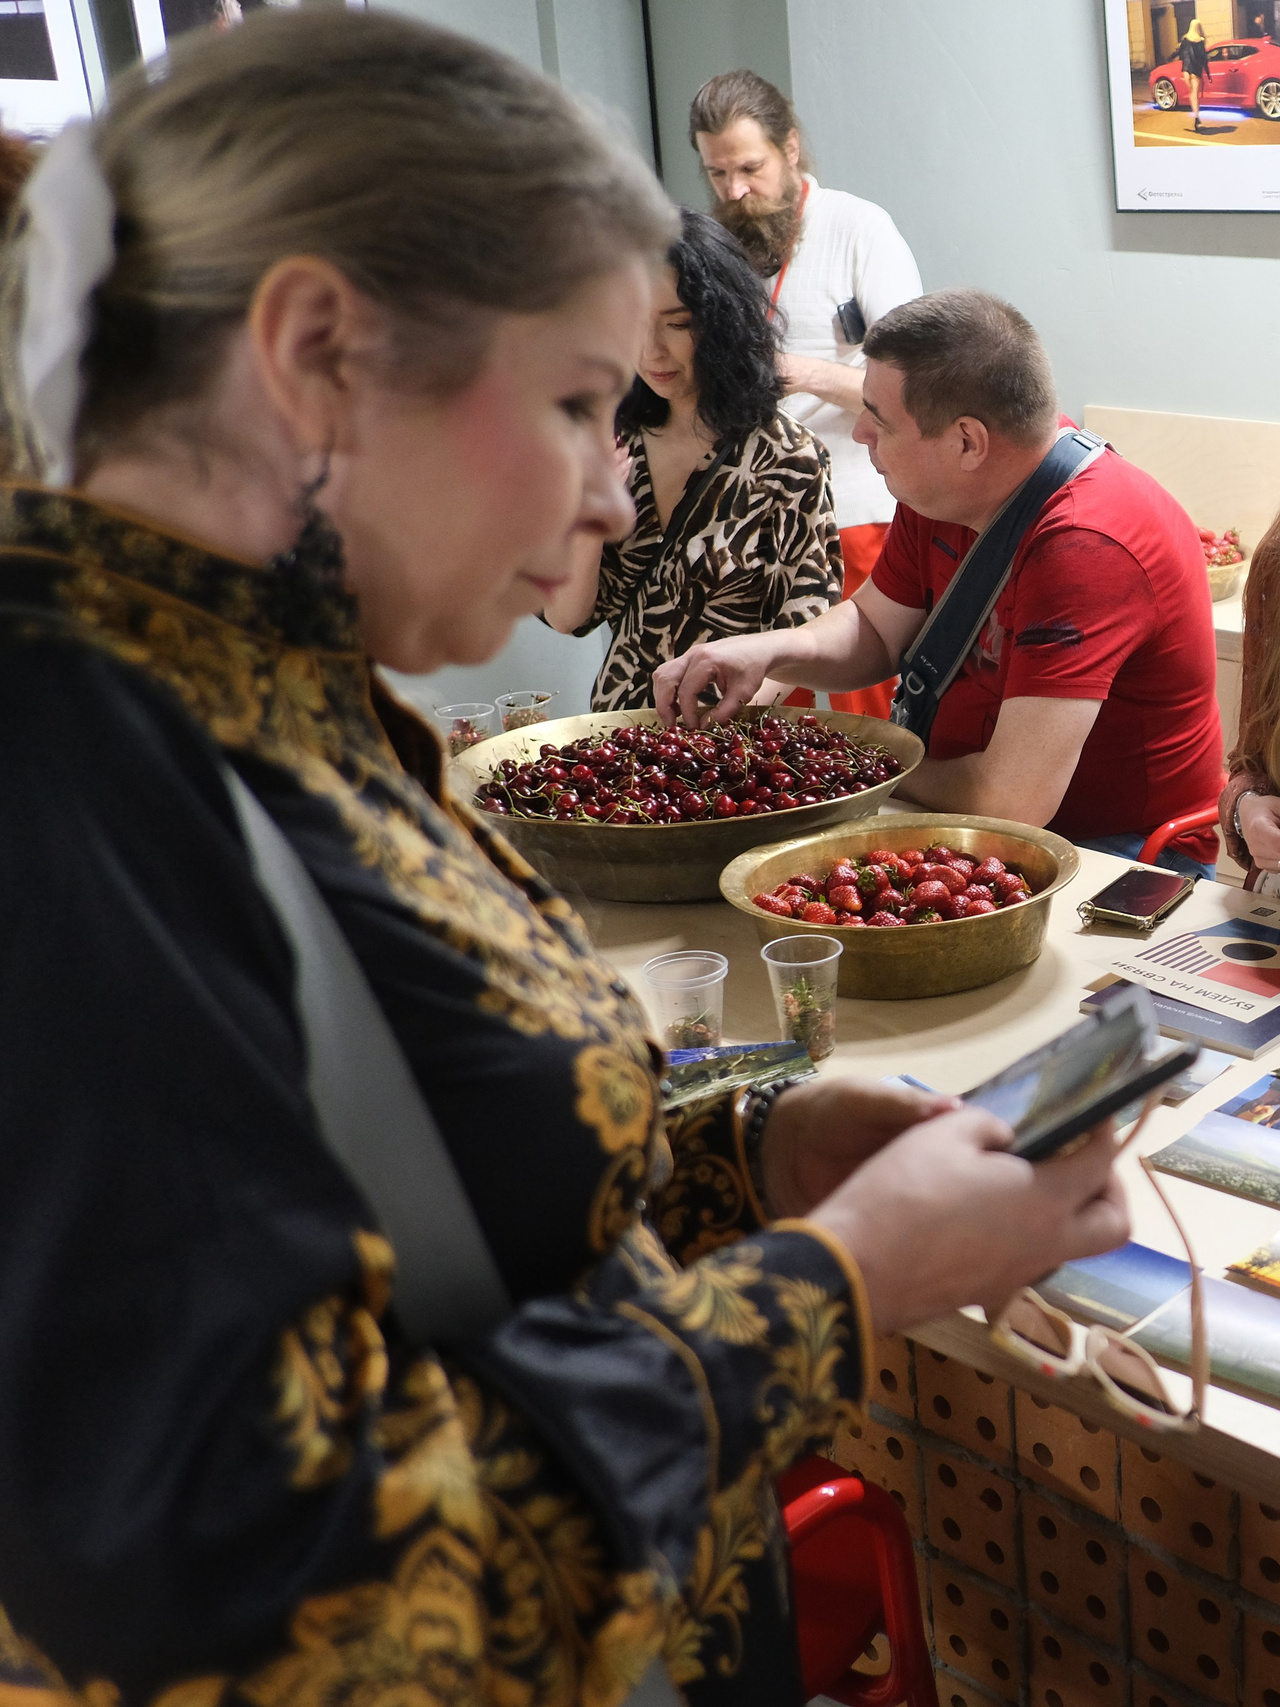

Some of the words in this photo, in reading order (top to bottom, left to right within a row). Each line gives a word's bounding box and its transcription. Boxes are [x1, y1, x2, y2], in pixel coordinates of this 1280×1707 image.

[1111, 961, 1167, 983] СВЯЗИ
[1169, 979, 1195, 992] НА
[1195, 988, 1255, 1011] БУДЕМ
